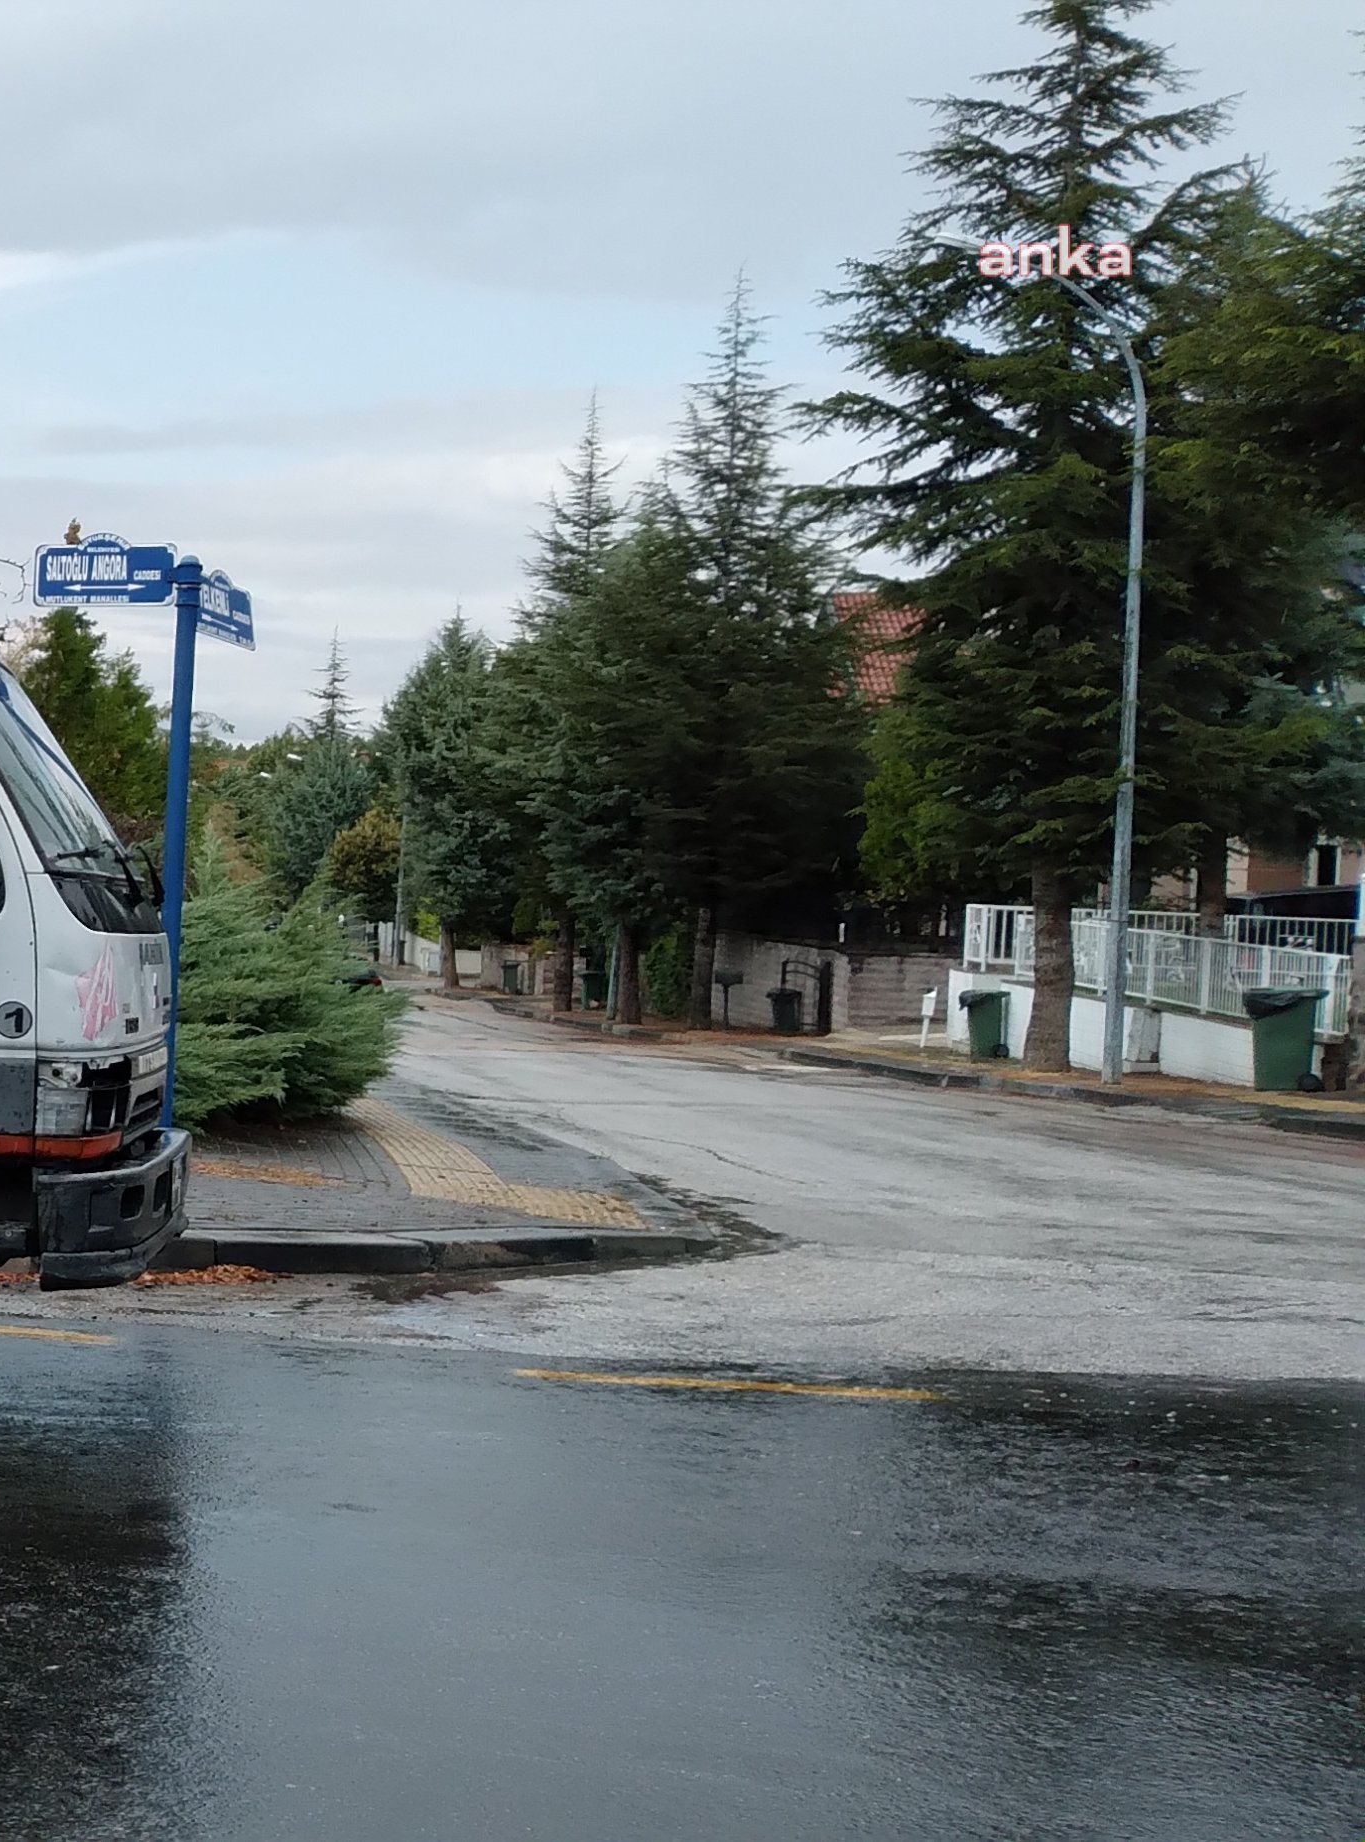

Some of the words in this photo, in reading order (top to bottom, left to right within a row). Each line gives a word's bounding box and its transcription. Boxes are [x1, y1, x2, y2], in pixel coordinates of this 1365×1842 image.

[45, 553, 89, 581] SALTOĞLU
[91, 555, 128, 580] ANGORA
[4, 1007, 23, 1032] 1
